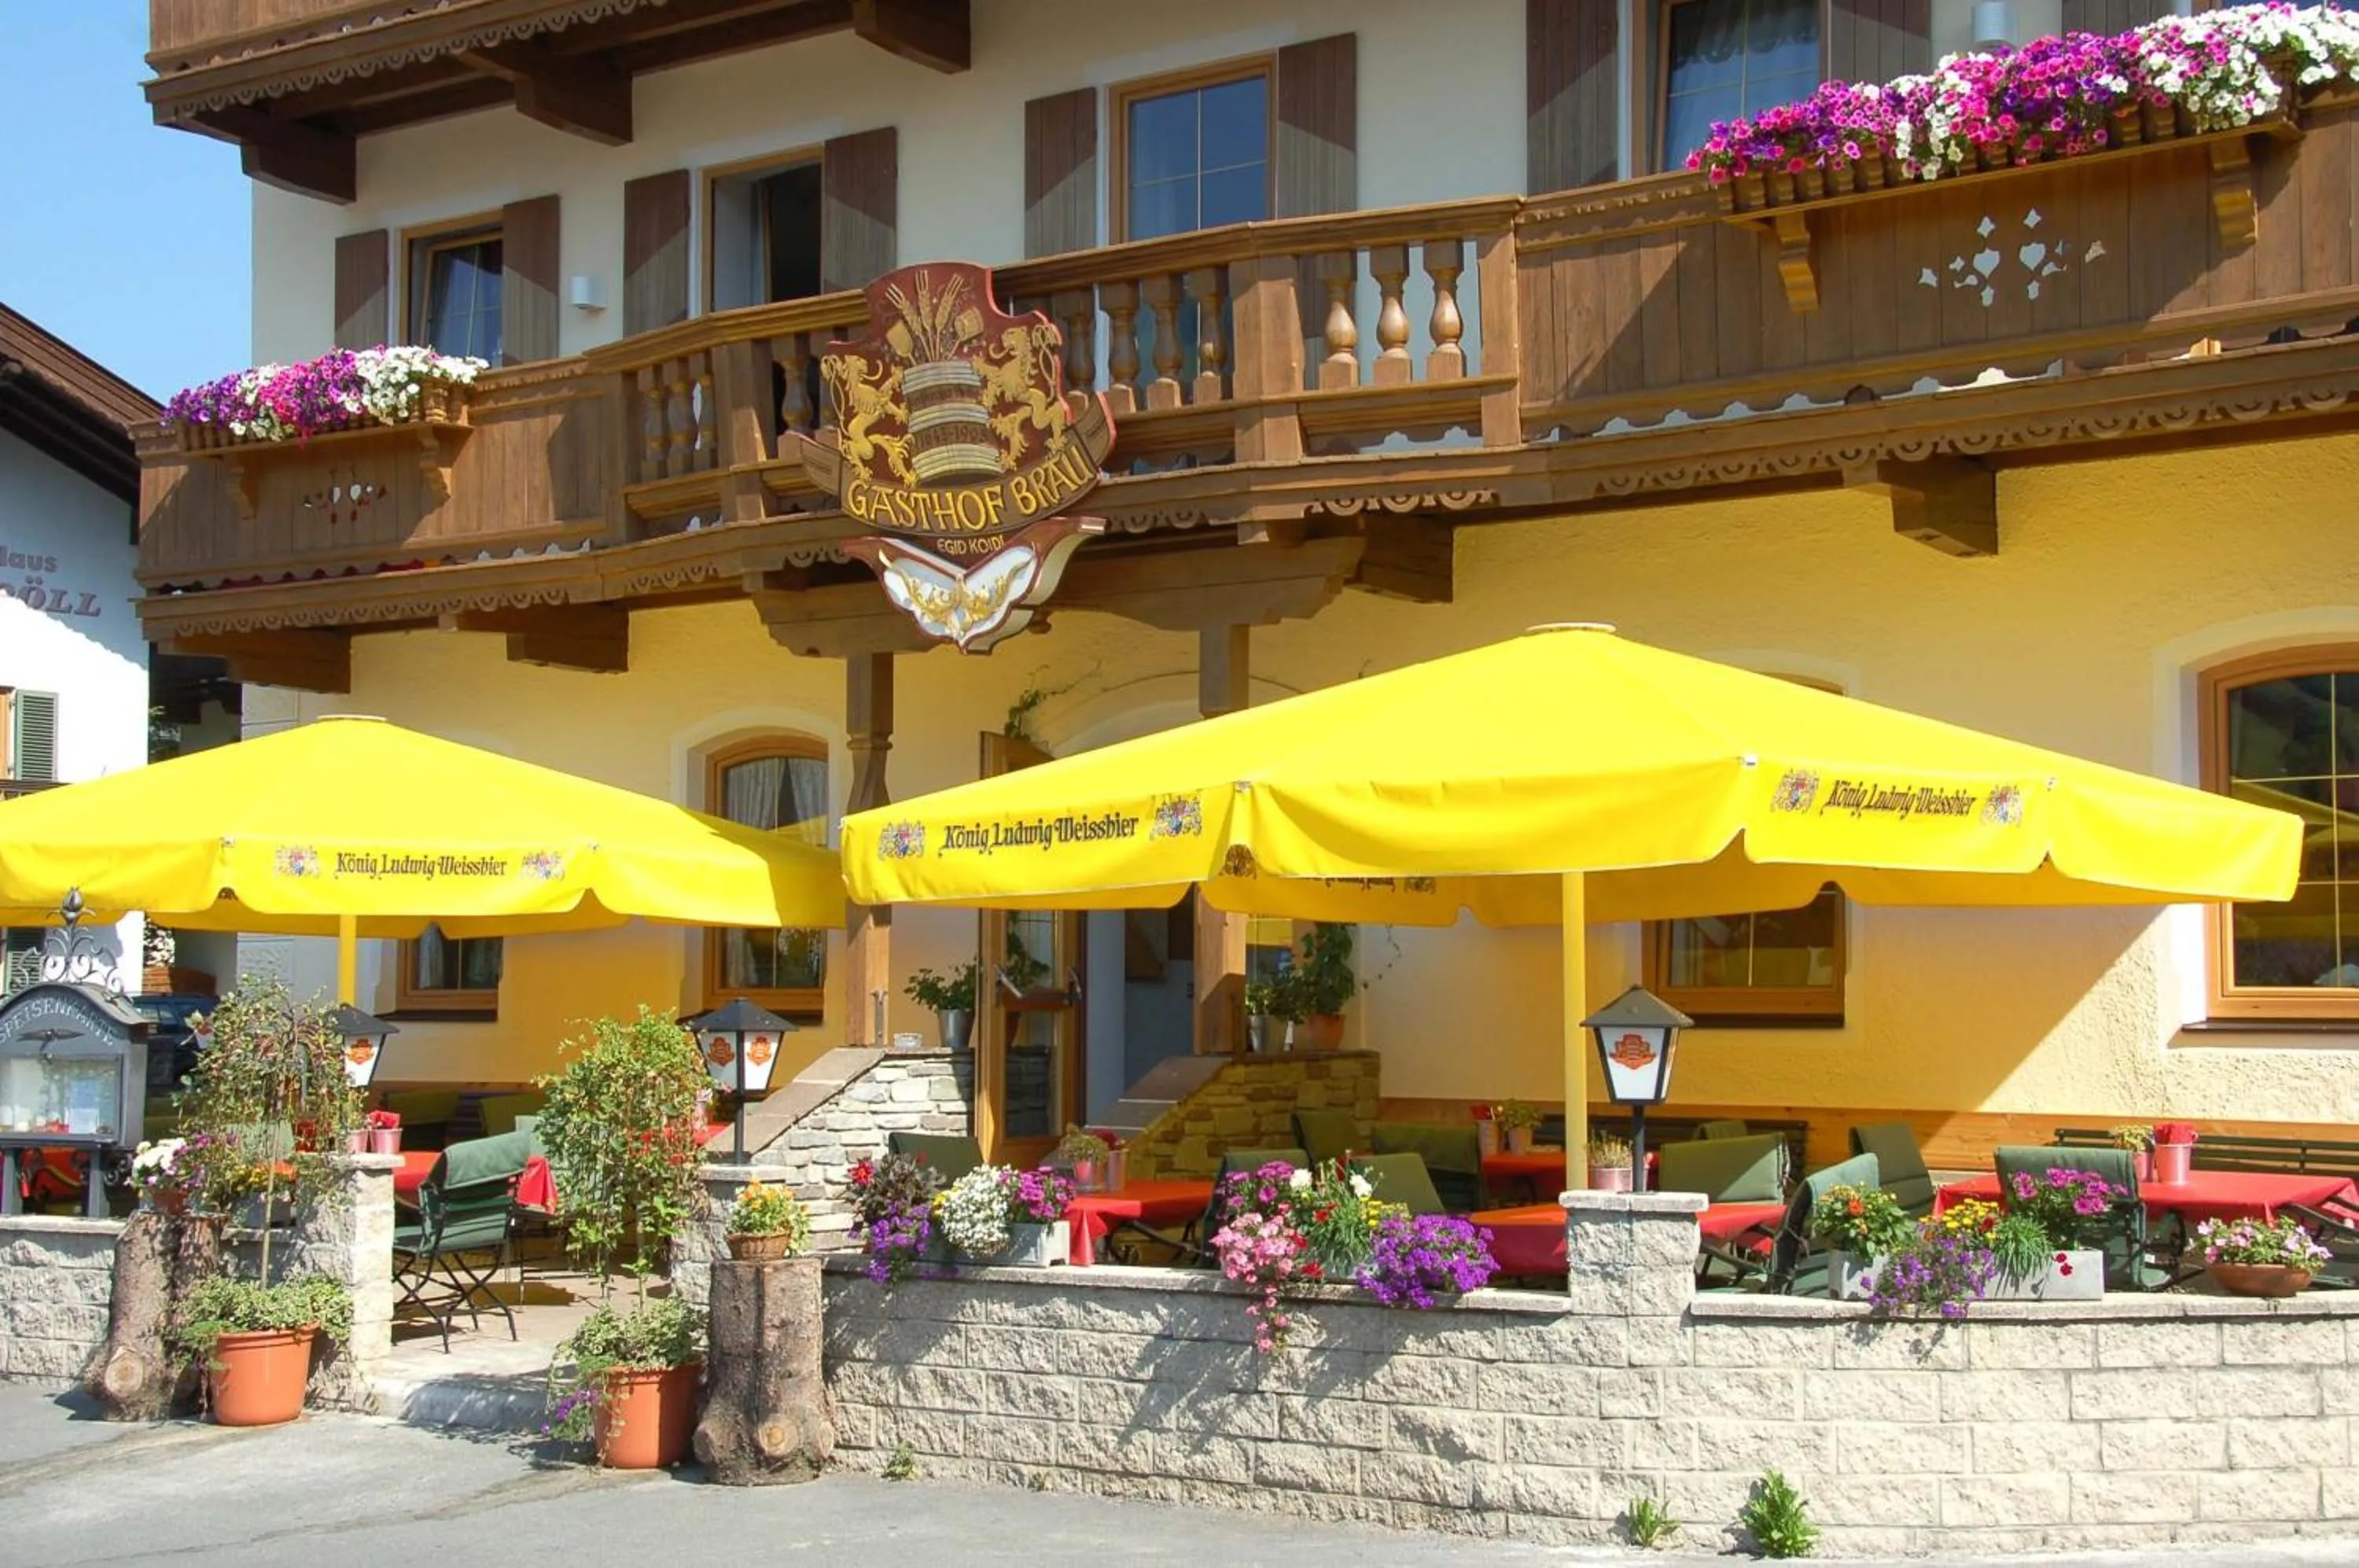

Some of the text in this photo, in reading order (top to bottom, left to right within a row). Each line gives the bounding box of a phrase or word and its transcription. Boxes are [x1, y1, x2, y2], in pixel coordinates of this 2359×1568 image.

[848, 479, 1005, 530] GASTHOF
[937, 538, 966, 554] EGID
[1818, 779, 1977, 819] König Ludwig Weissbier
[937, 812, 1139, 857] König Ludwig Weissbier
[334, 852, 507, 882] König Ludwig Weissbier
